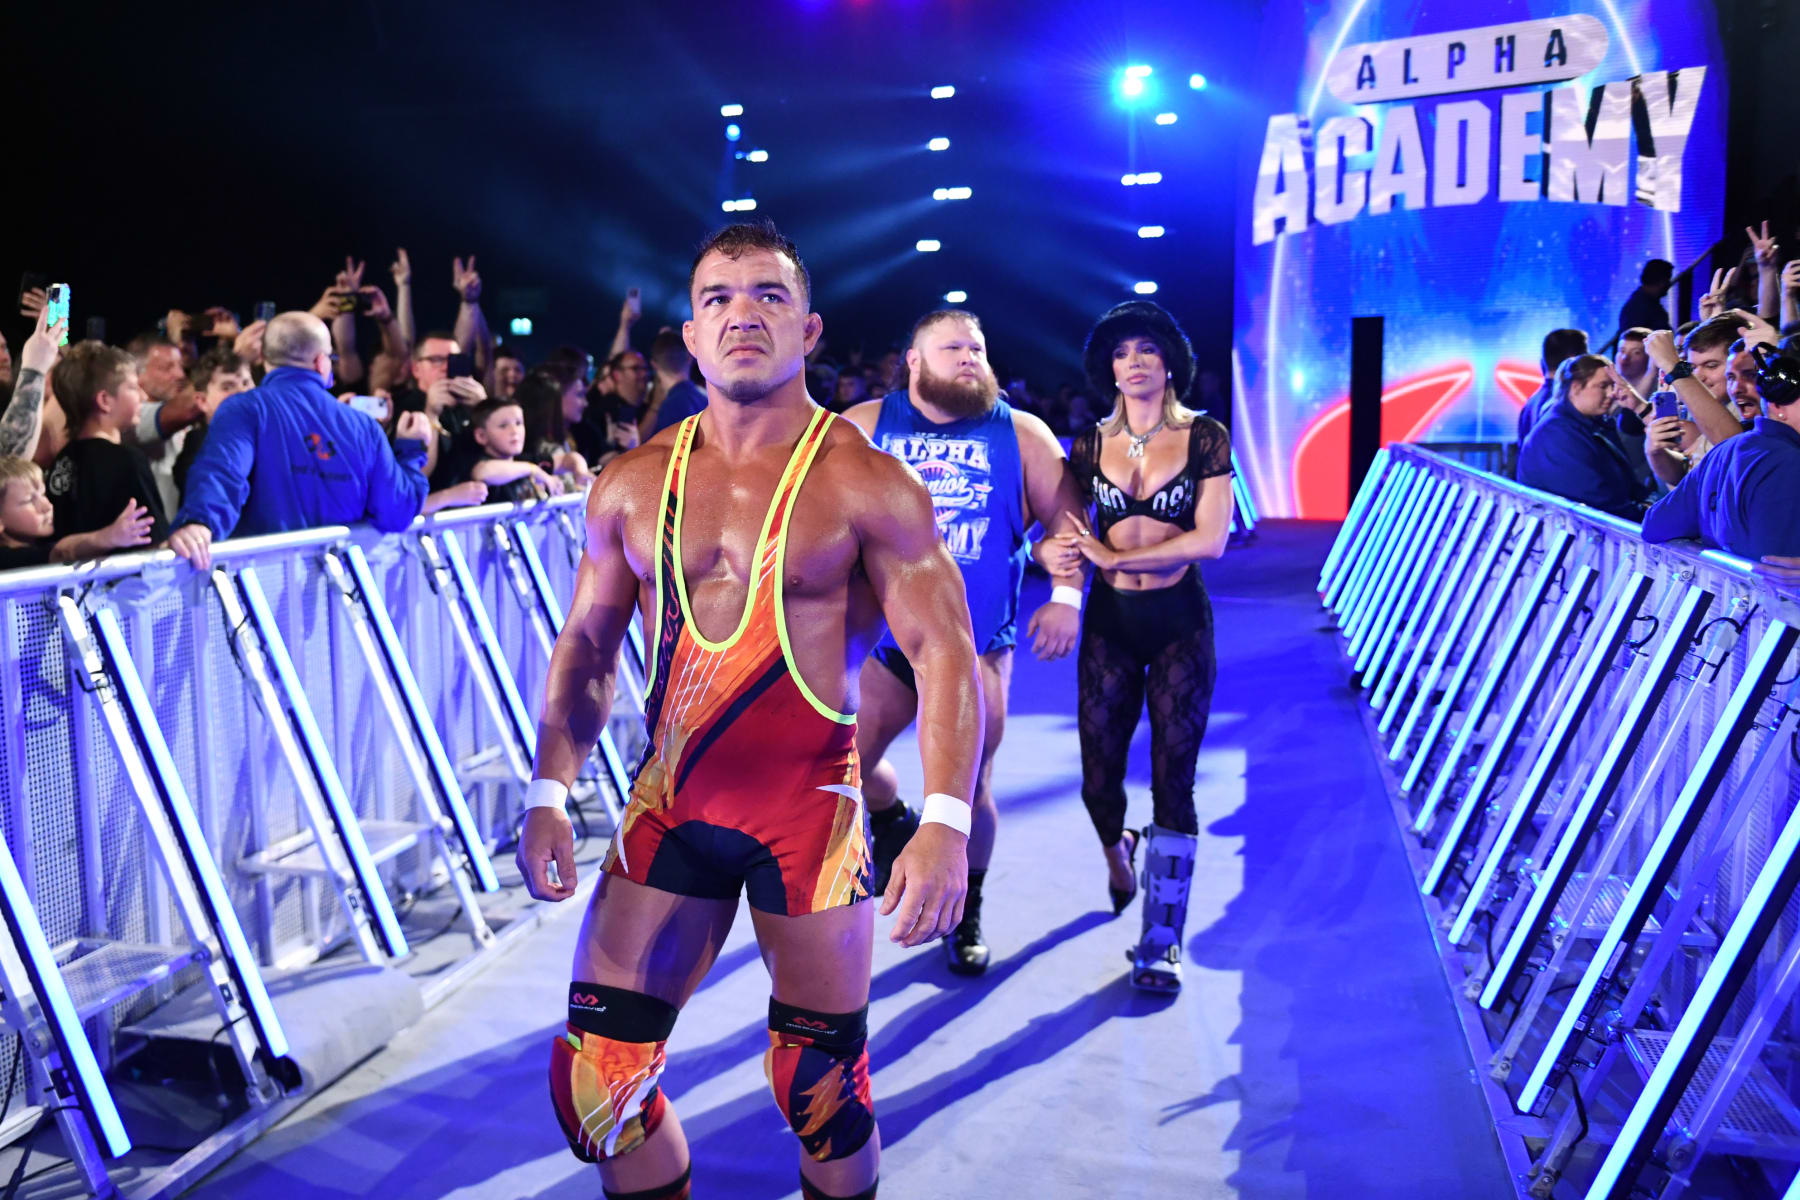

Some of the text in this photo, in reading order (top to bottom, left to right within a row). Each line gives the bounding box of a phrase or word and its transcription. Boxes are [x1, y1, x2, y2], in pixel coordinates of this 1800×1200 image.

[1356, 28, 1568, 90] ALPHA
[1252, 65, 1708, 247] ACADEMY
[889, 437, 991, 473] ALPHA
